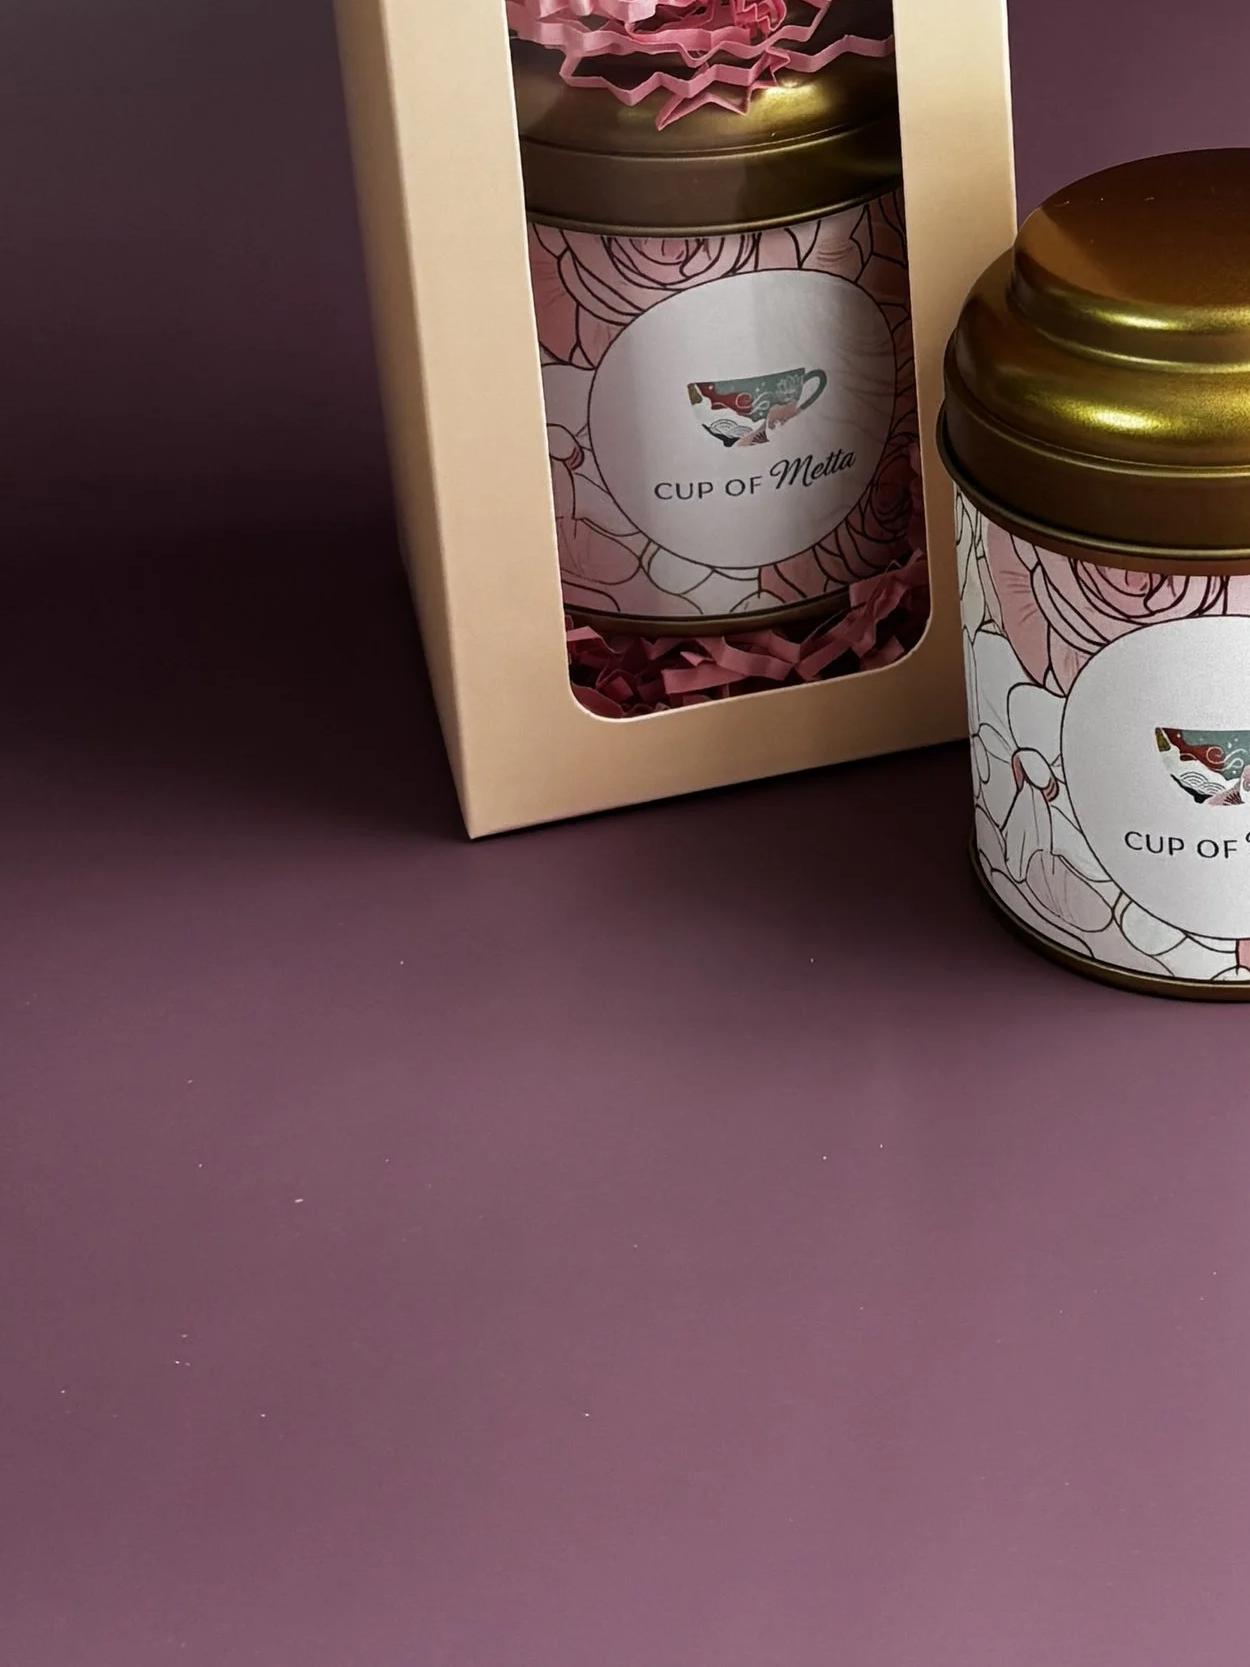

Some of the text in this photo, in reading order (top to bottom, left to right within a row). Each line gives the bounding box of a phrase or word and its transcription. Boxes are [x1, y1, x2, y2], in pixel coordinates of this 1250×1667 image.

[654, 448, 857, 501] CUP OF Metta
[1124, 831, 1185, 857] CUP
[1196, 839, 1238, 858] OF
